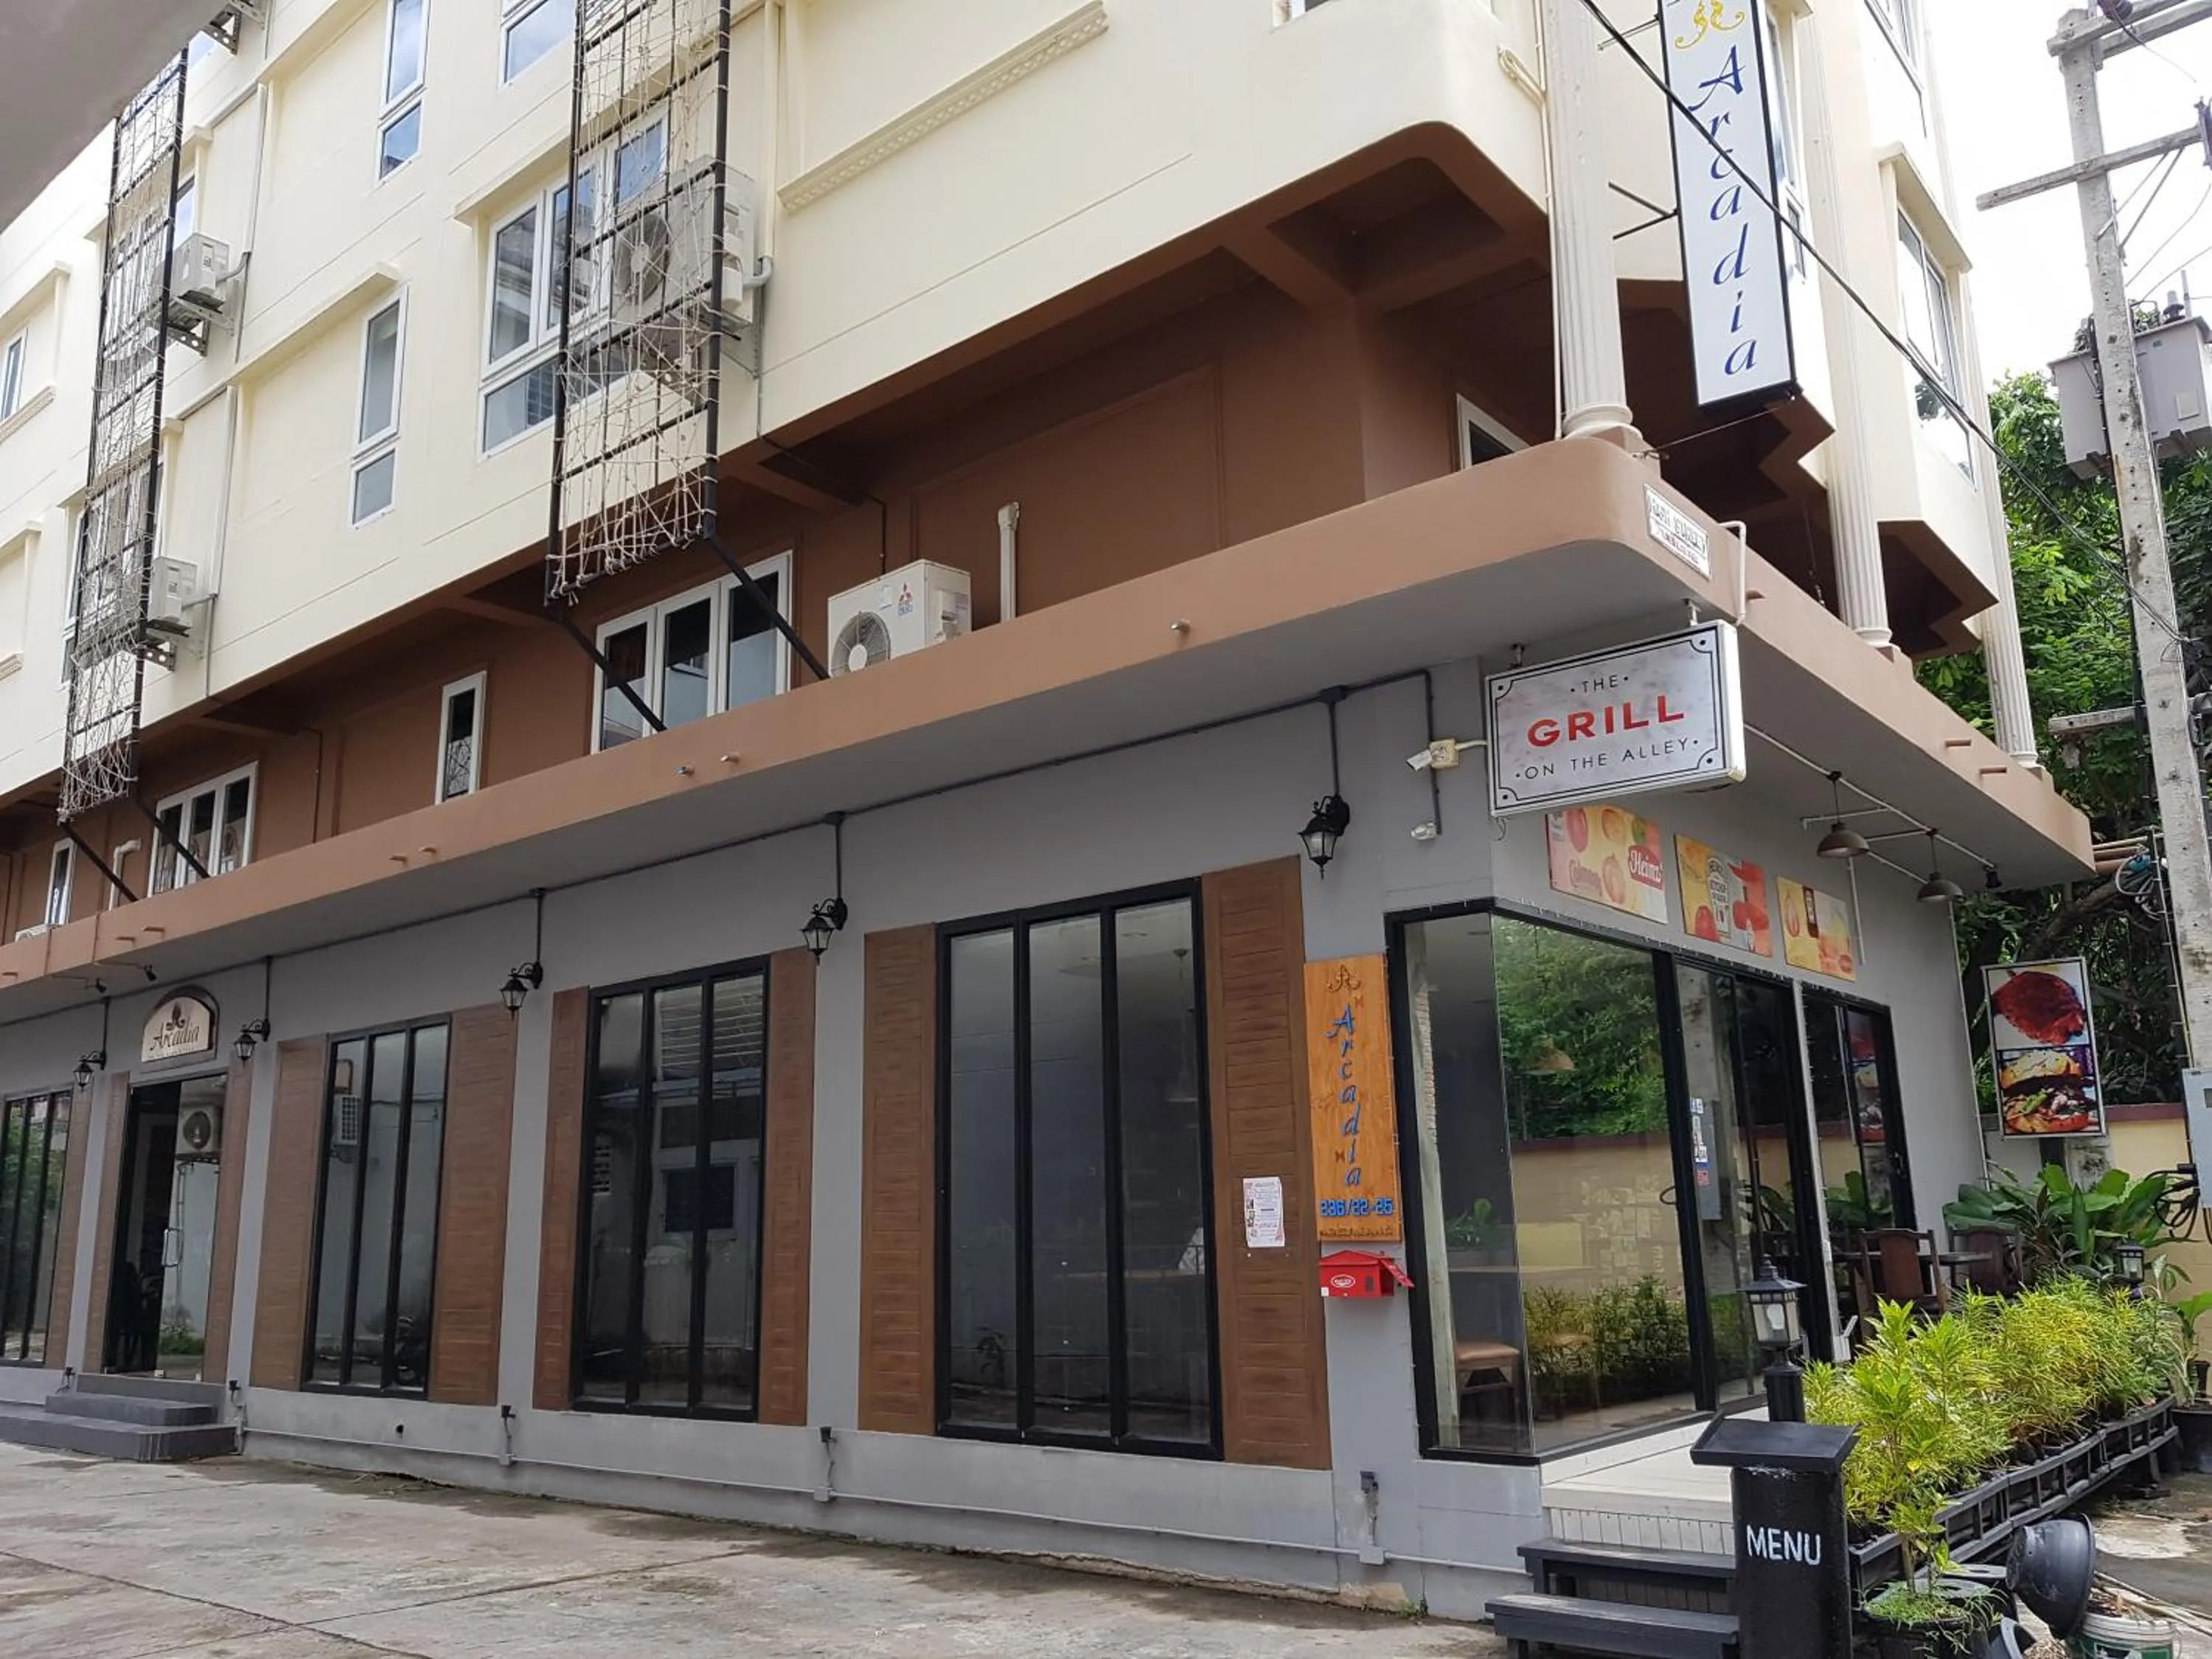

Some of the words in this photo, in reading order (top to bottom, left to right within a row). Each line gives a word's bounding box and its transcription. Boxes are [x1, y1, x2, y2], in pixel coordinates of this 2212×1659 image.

[1688, 44, 1757, 375] Arcadia
[1582, 675, 1618, 693] THE
[1527, 695, 1685, 748] GRILL
[1525, 764, 1554, 780] ON
[1570, 753, 1608, 771] THE
[1621, 737, 1688, 763] ALLEY
[1324, 1002, 1362, 1186] Arcadia
[1746, 1524, 1821, 1566] MENU
